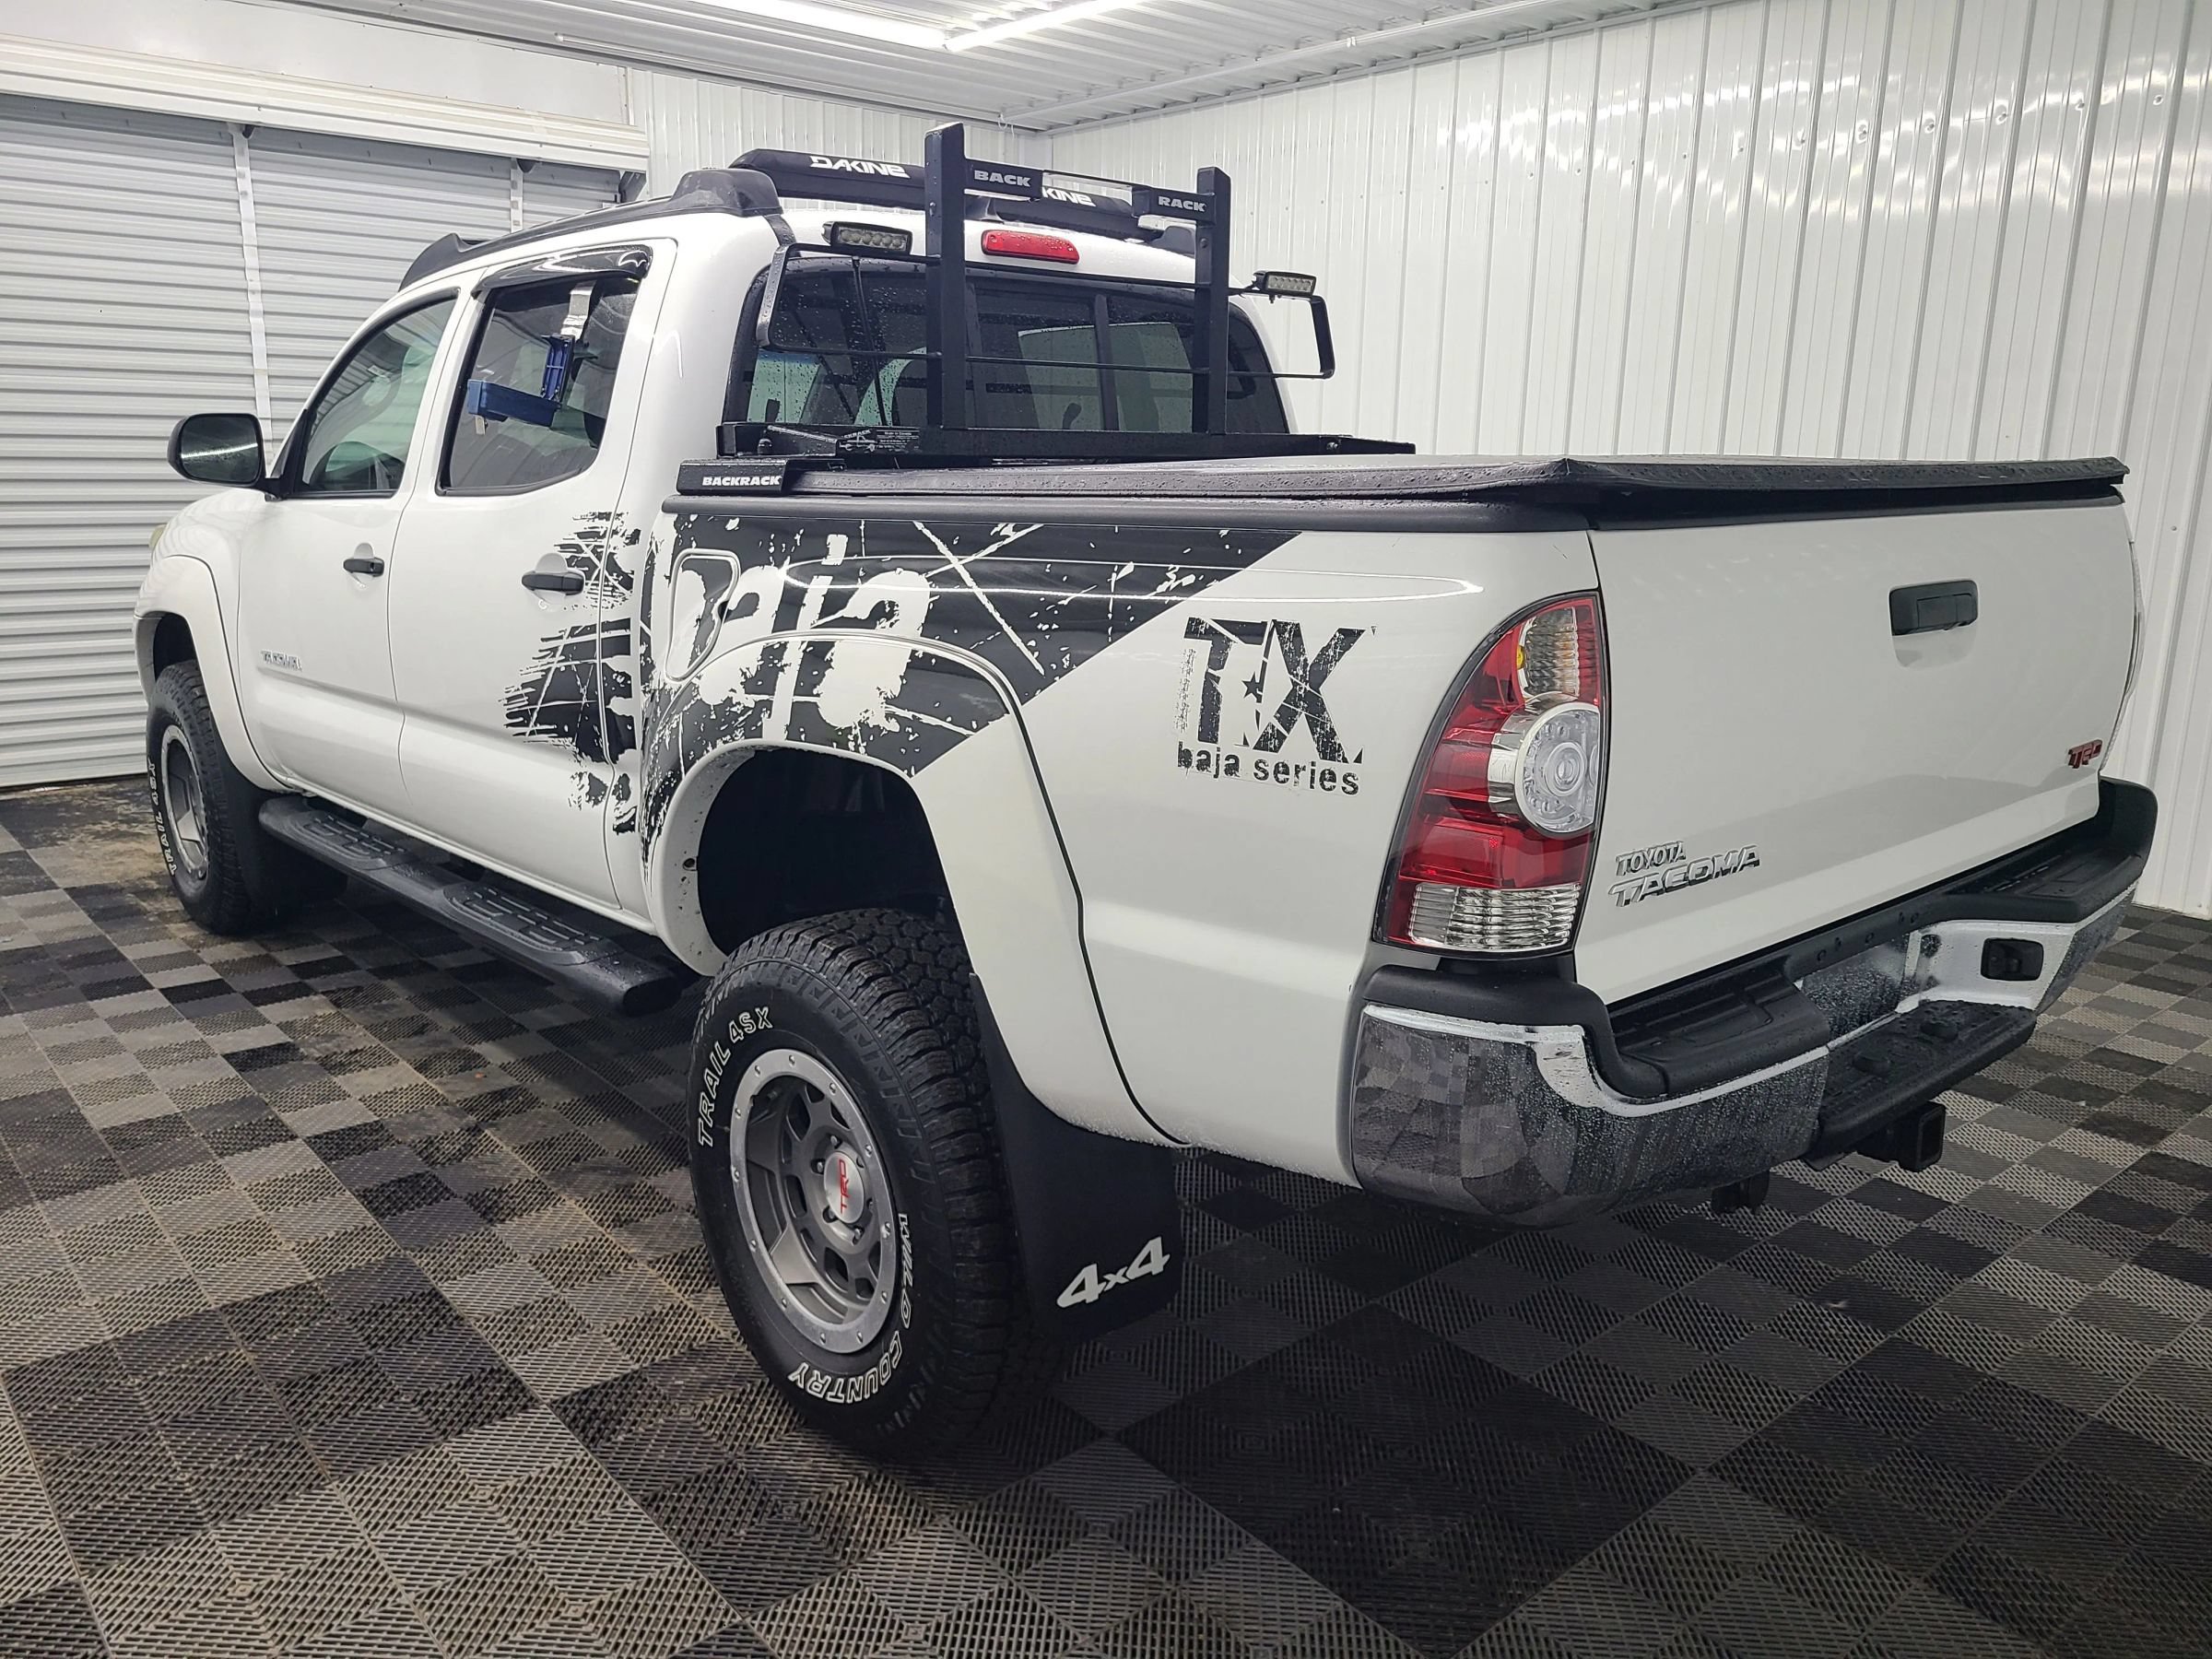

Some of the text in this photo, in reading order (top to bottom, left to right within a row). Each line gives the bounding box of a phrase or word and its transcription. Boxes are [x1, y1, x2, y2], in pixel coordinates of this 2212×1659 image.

[809, 155, 911, 179] DAKINE
[974, 170, 1206, 212] BACK RACK
[1042, 186, 1097, 207] KINE
[701, 476, 782, 487] BACKRACK
[1182, 617, 1368, 764] TX
[1177, 740, 1360, 796] baja series
[2067, 739, 2103, 769] TRD
[1607, 844, 1760, 907] TACOMA
[1616, 841, 1687, 876] TOYOTA
[698, 1006, 773, 1147] TRAIL 4SX
[839, 1159, 850, 1215] TRD
[1056, 1236, 1171, 1308] 4x4
[787, 1212, 913, 1404] WILD COUNTRY
